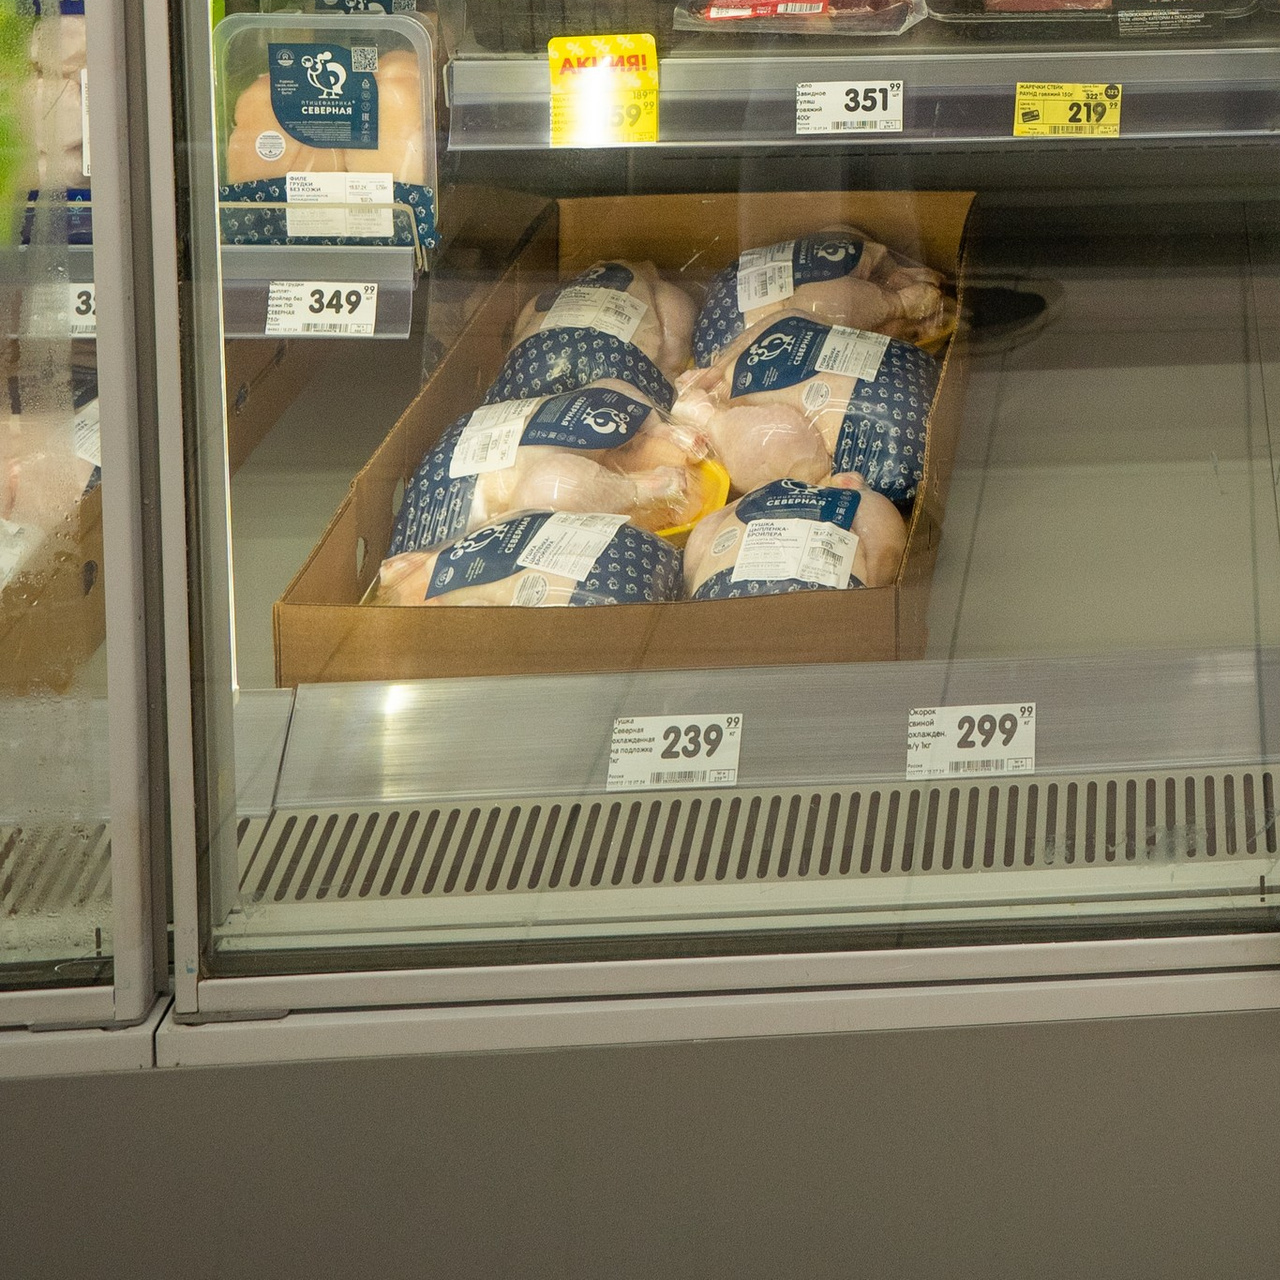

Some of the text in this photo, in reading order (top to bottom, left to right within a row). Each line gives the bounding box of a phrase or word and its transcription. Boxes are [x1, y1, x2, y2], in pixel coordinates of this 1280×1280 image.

[844, 83, 901, 112] 351 99
[301, 106, 352, 115] СЕВЕРНАЯ
[1068, 102, 1107, 123] 219
[308, 285, 375, 314] 349 99
[766, 498, 826, 507] СЕВЕРНАЯ
[909, 708, 937, 717] Окорок
[908, 718, 935, 728] свиной
[957, 705, 1034, 748] 299 99
[613, 727, 644, 735] Северная
[661, 716, 740, 759] 239 99
